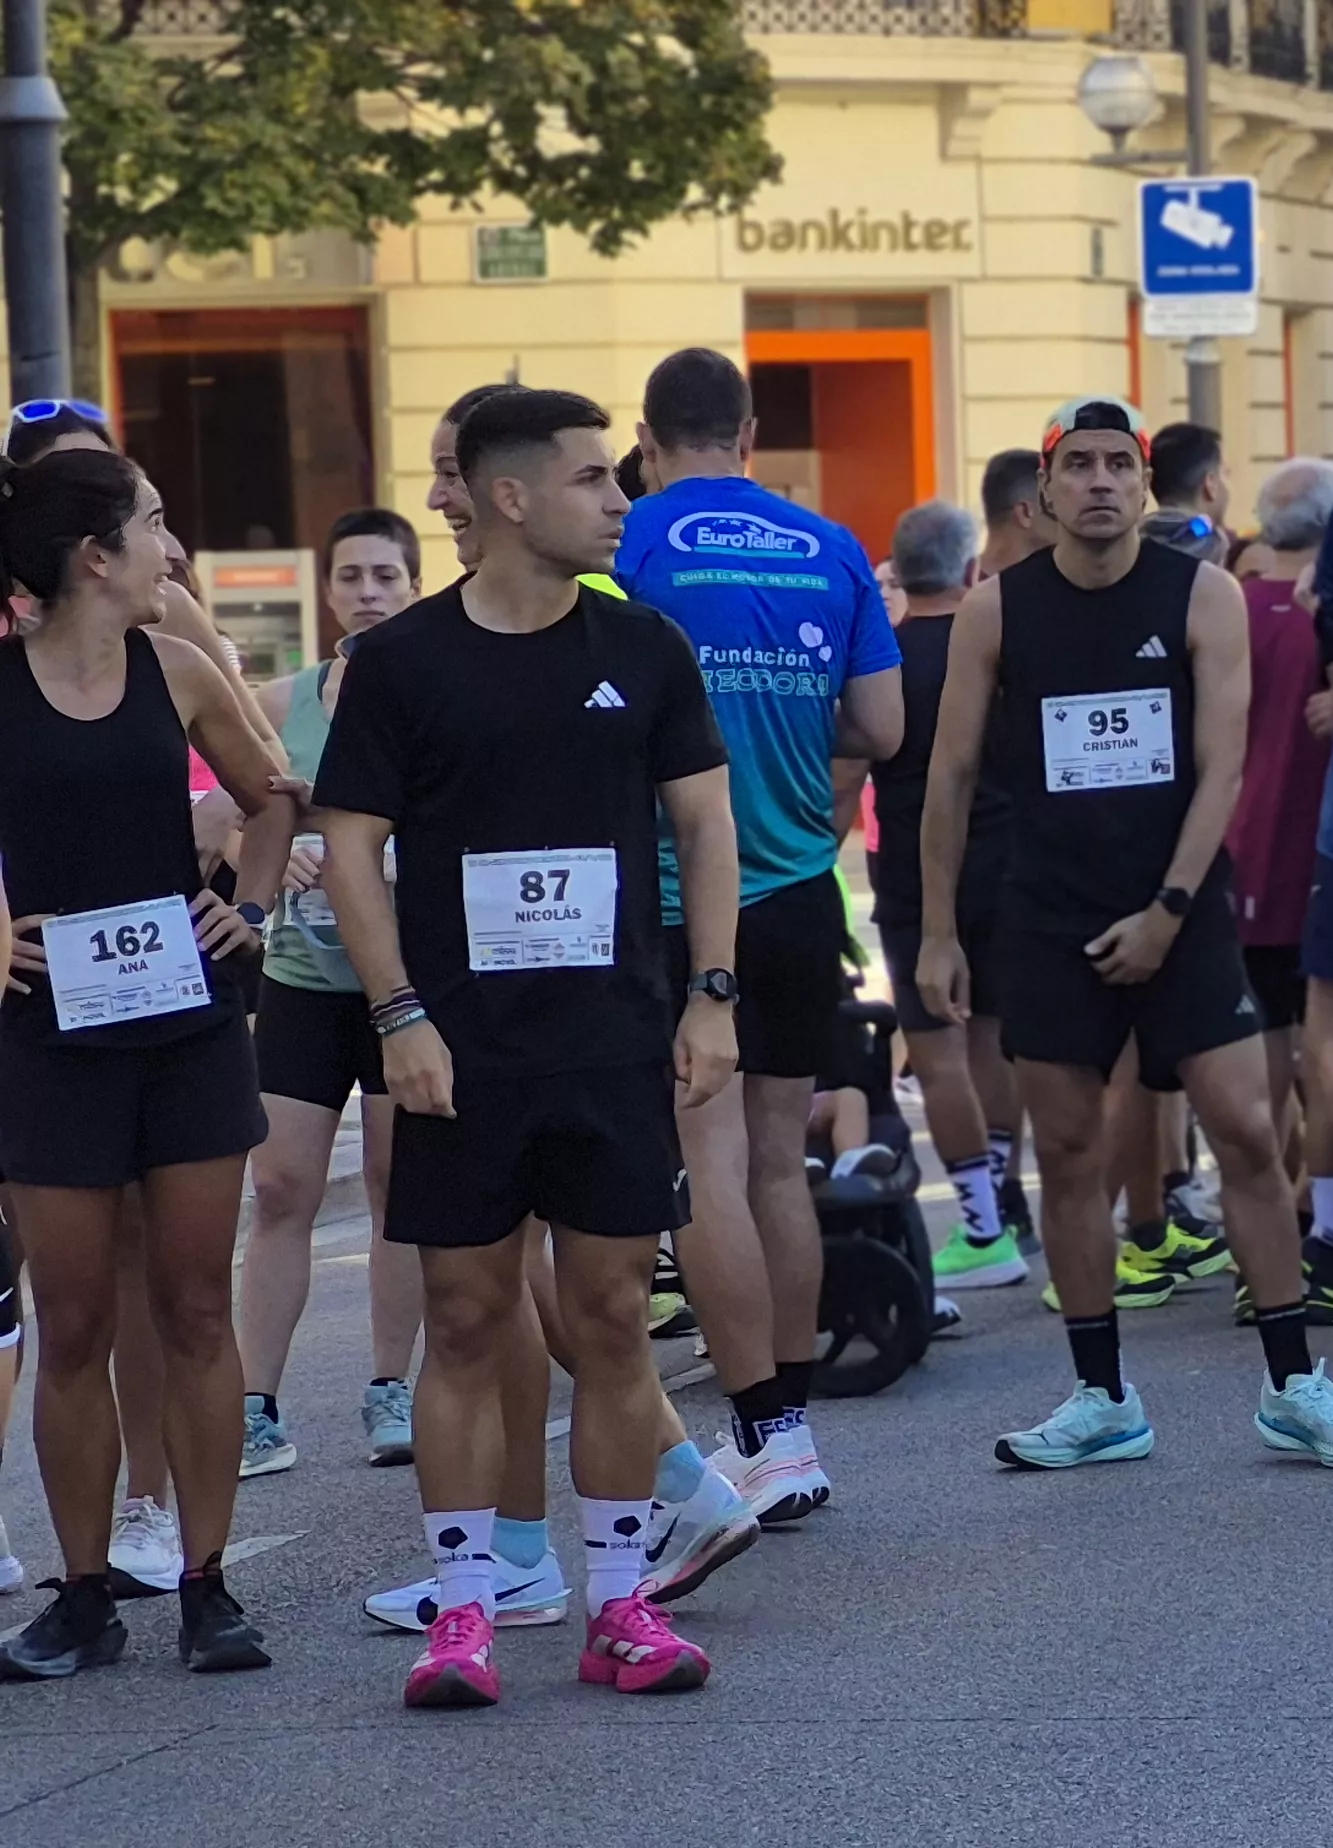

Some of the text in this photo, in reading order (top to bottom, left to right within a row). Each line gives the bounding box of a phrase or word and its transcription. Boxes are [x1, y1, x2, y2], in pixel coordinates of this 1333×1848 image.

[697, 526, 797, 550] EuroTaller
[700, 645, 810, 667] Fundación
[1088, 708, 1129, 736] 95
[1083, 738, 1138, 752] CRISTIAN
[519, 868, 571, 903] 87
[515, 904, 582, 923] NICOLÁS
[90, 920, 164, 963] 162
[118, 959, 149, 976] ANA
